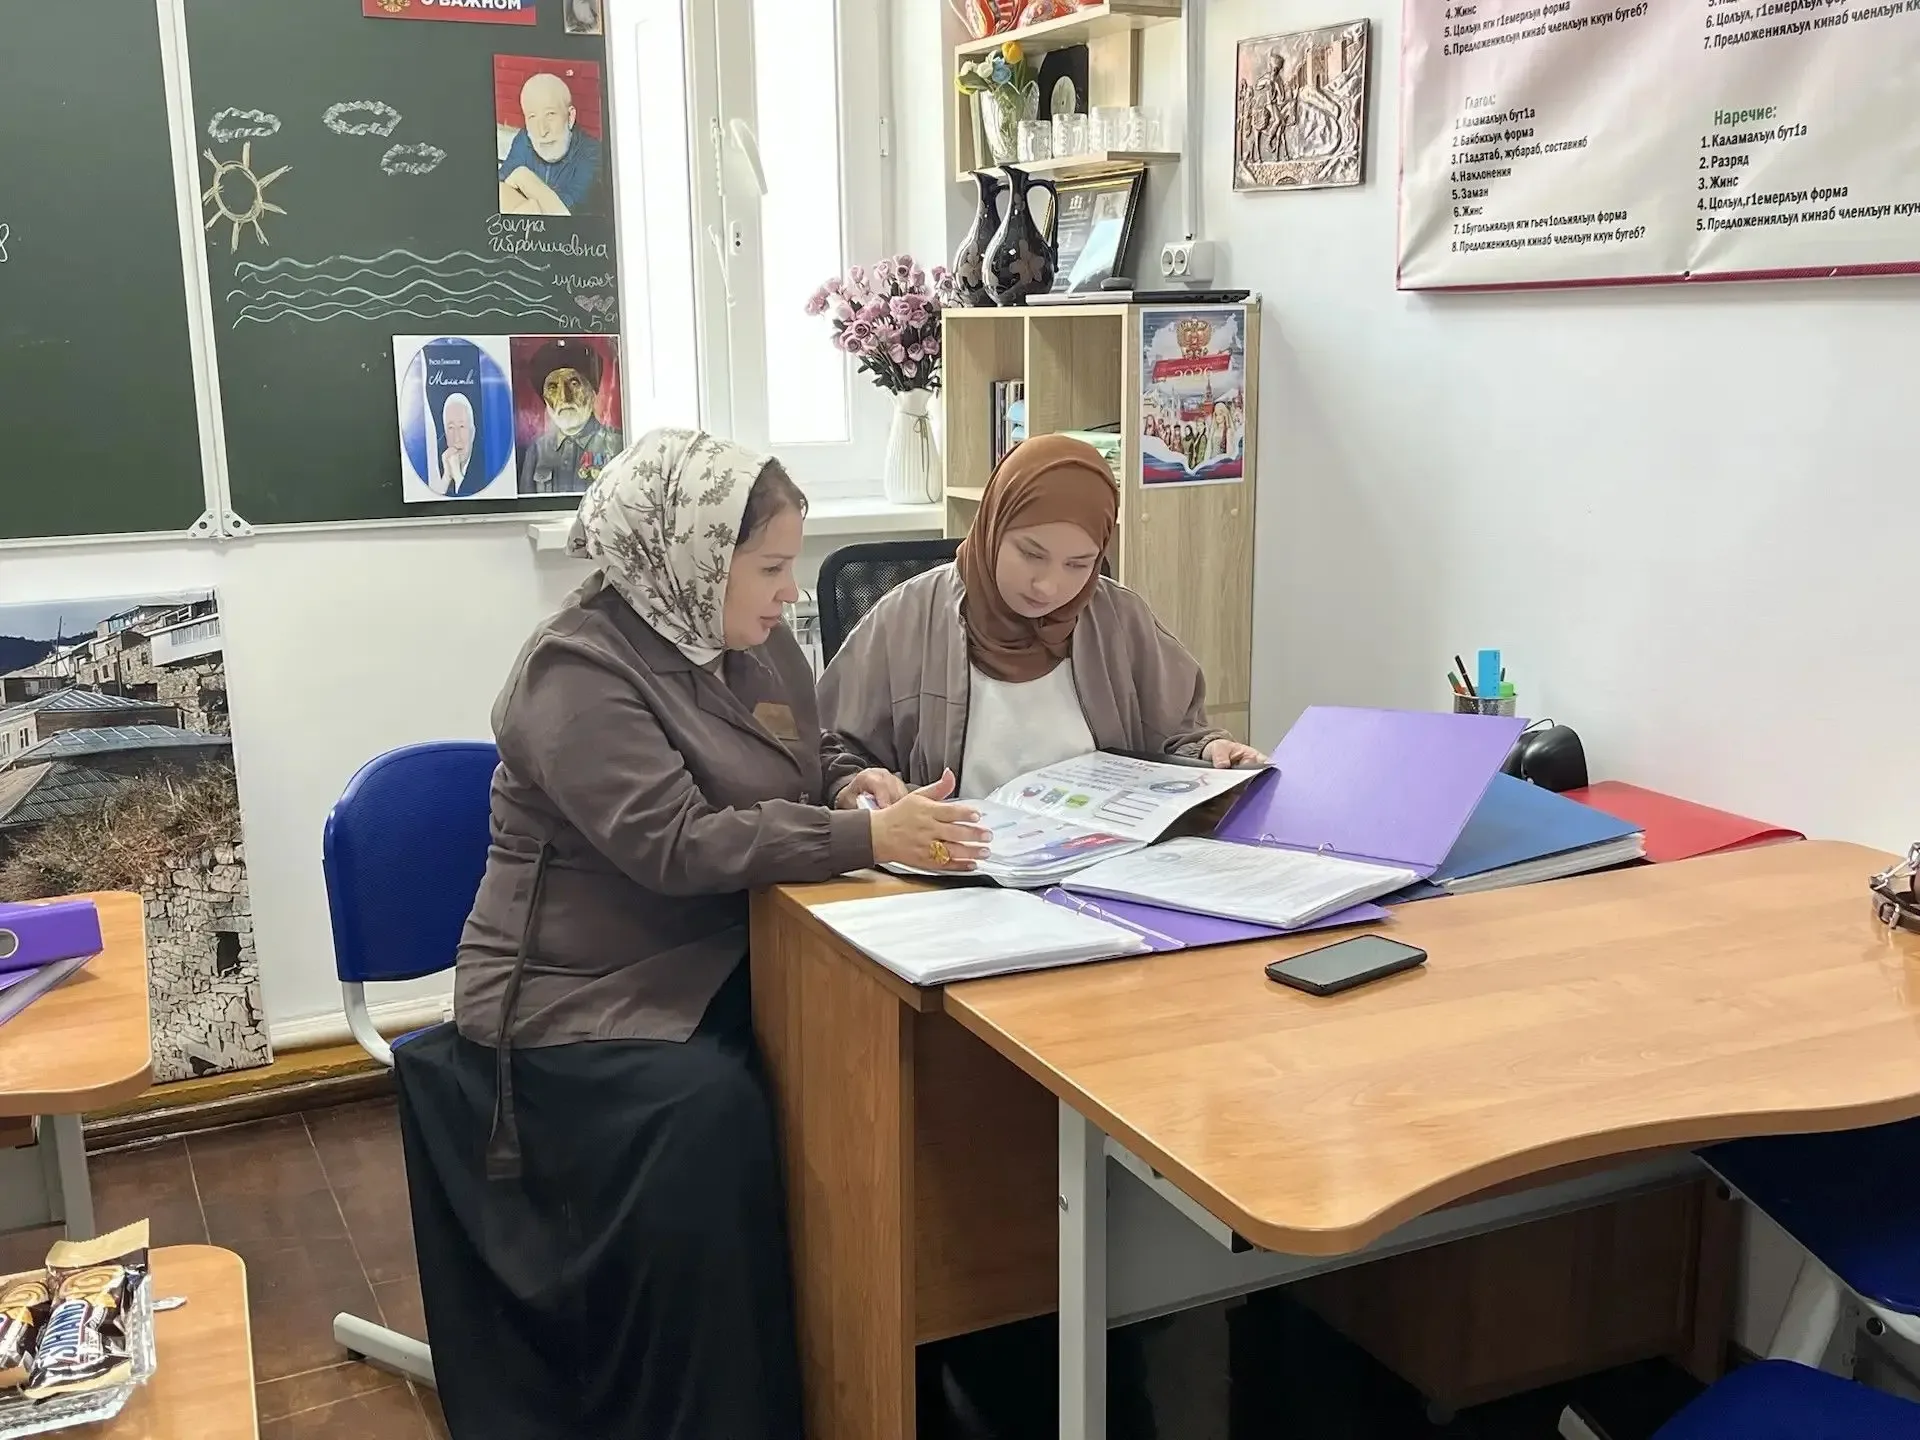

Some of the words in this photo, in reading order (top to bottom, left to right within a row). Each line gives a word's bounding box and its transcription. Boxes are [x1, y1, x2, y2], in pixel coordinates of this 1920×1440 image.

[1454, 5, 1477, 18] Жинс
[1543, 1, 1571, 19] форма
[1716, 10, 1754, 26] Цолъул,
[1521, 22, 1546, 40] кинаб
[1548, 16, 1588, 34] членлъун
[1590, 12, 1613, 28] ккун
[1615, 2, 1649, 24] бугеб?
[1714, 19, 1811, 49] Предложениялъул
[1813, 9, 1849, 29] кинаб
[1851, 2, 1903, 22] членлъун
[1509, 107, 1536, 123] бут1а
[1714, 106, 1777, 127] Наречие:
[1504, 128, 1534, 143] форма
[1711, 129, 1775, 147] Каламалъул
[1777, 123, 1807, 139] бут1а
[1711, 154, 1749, 170] Разряд
[1460, 167, 1512, 182] Наклонения
[1710, 175, 1739, 189] Жинс
[1461, 188, 1489, 199] Заман
[1810, 185, 1848, 205] форма
[1462, 205, 1483, 217] Жинс
[1516, 219, 1529, 229] яги
[1597, 210, 1627, 224] форма
[1707, 212, 1799, 232] Предложениялъул
[1801, 206, 1836, 222] кинаб
[1839, 203, 1891, 219] членлъун
[1894, 202, 1920, 217] ккун
[1527, 233, 1552, 247] кинаб
[1554, 233, 1592, 245] членлъун
[1593, 231, 1613, 243] ккун
[1615, 226, 1645, 242] бугеб?
